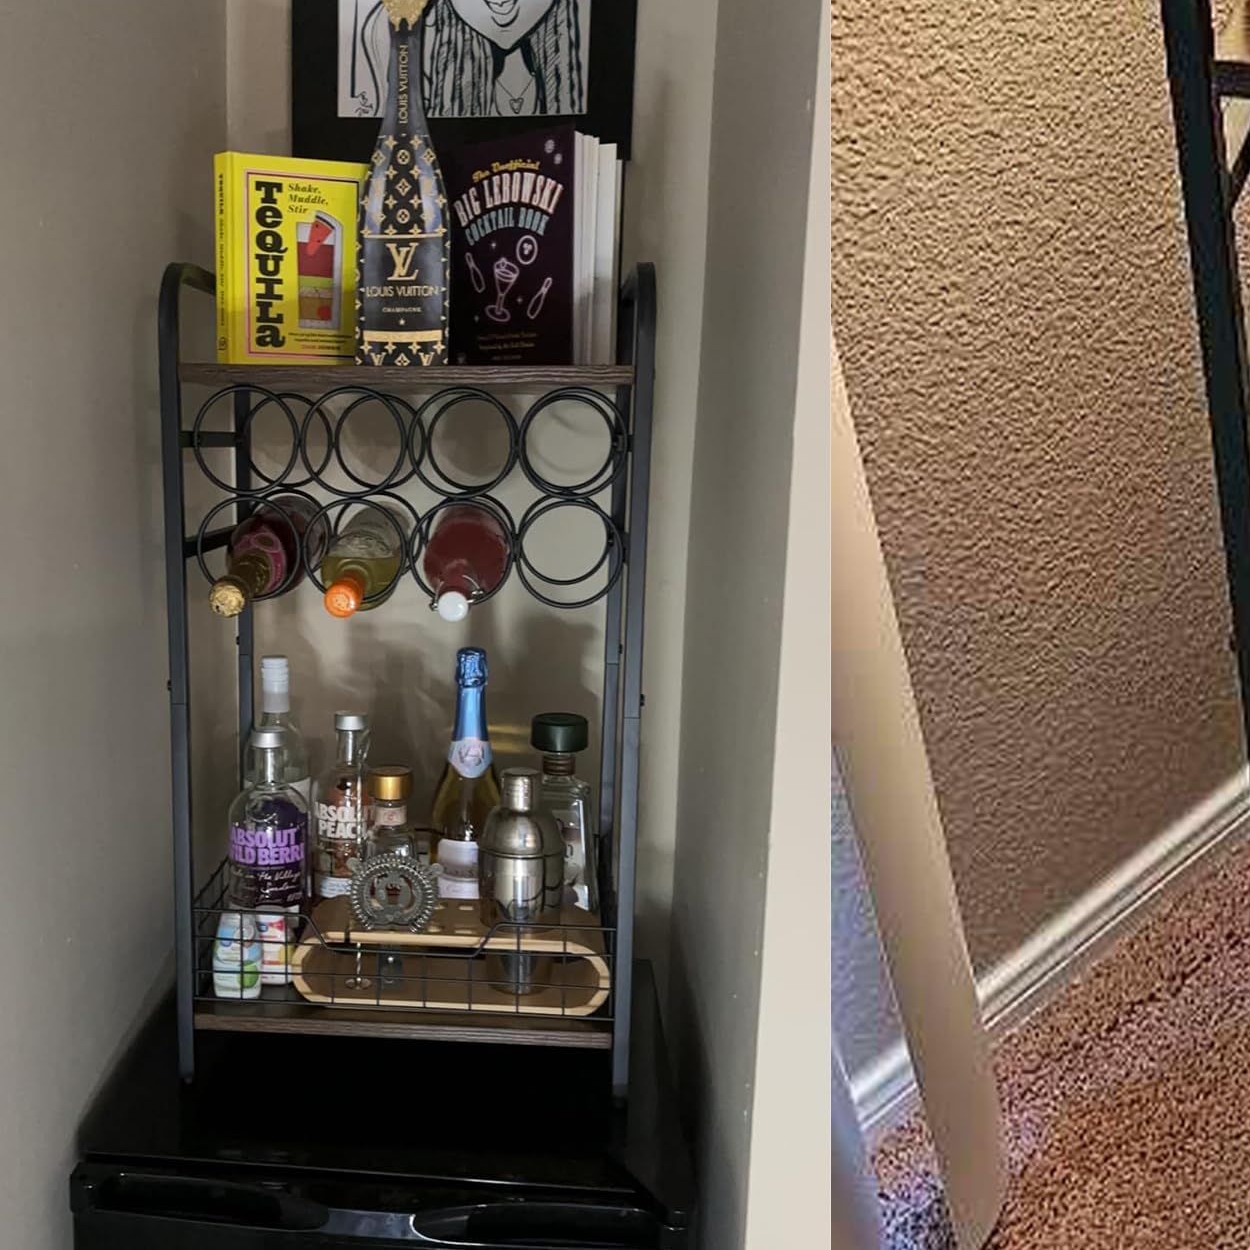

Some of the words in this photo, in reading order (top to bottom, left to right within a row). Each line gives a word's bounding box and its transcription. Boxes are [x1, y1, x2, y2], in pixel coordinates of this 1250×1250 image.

[398, 45, 408, 91] VUITTON
[398, 91, 408, 125] LOUIS
[453, 186, 481, 228] BIG
[482, 171, 564, 215] LEBOWSKI
[365, 285, 395, 297] LOUIS
[396, 285, 440, 297] VUITTON
